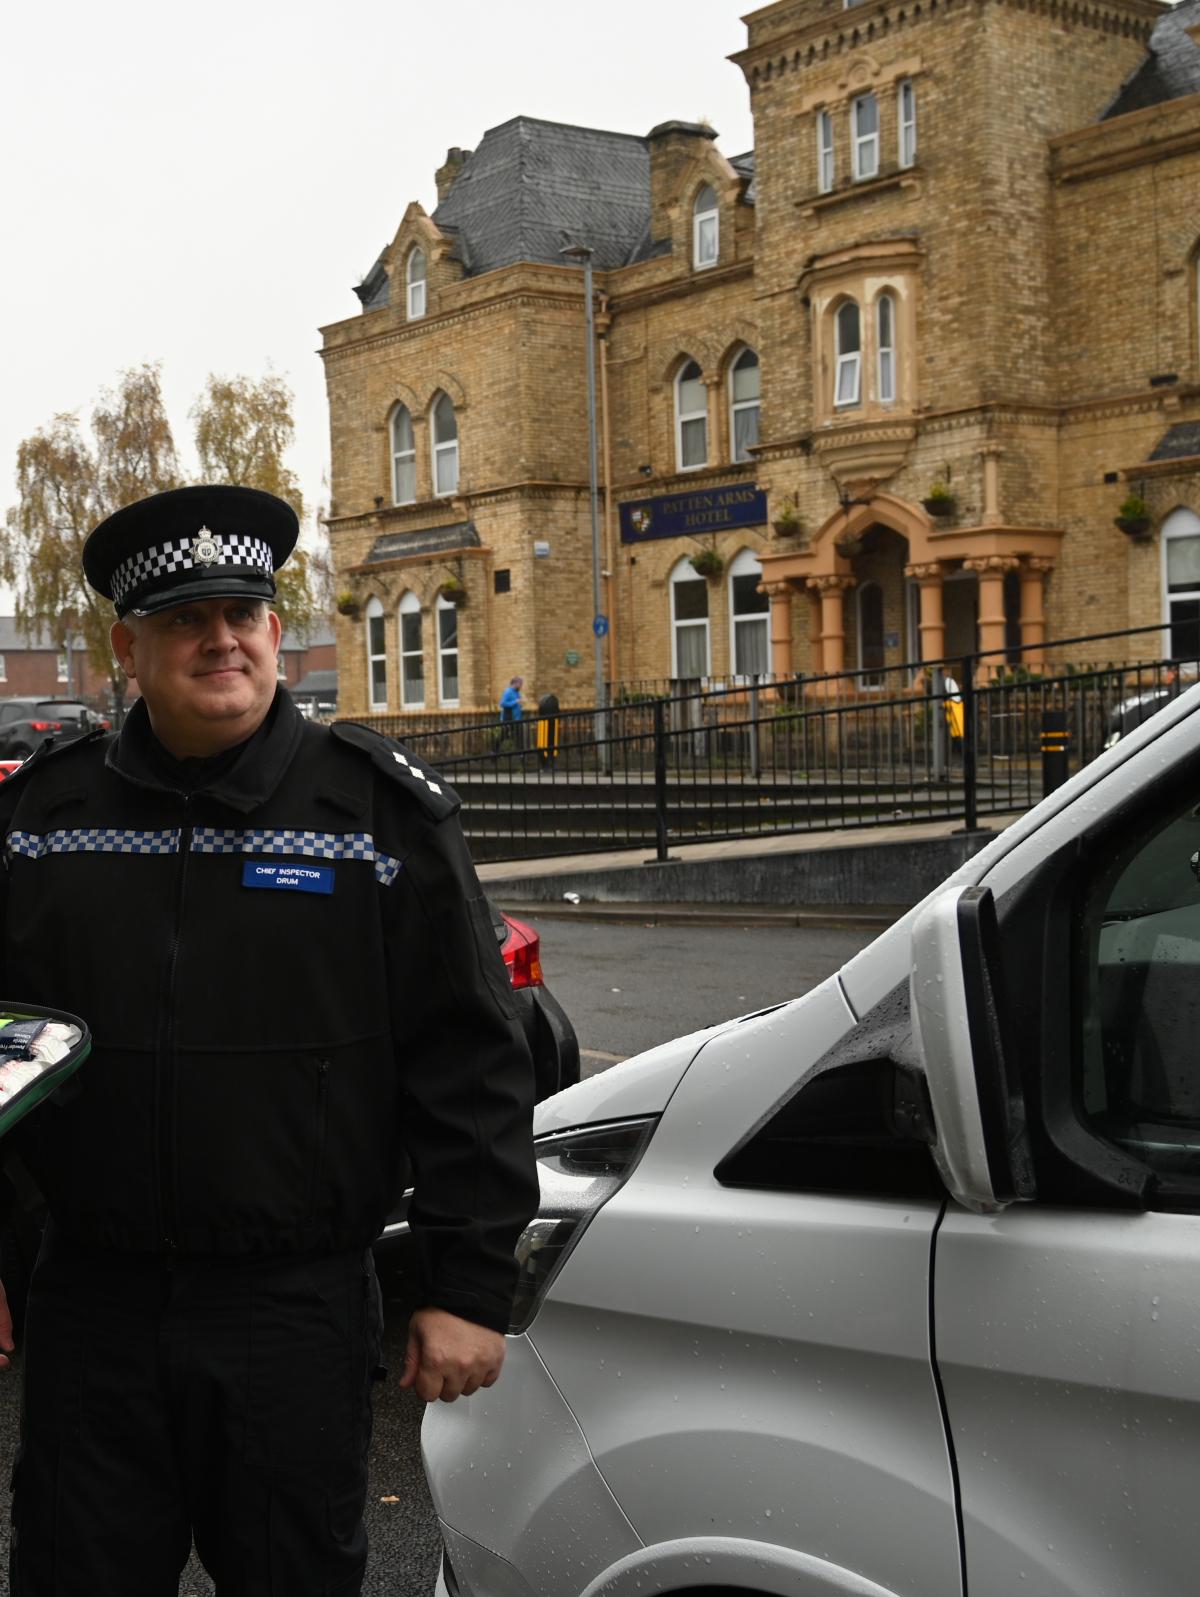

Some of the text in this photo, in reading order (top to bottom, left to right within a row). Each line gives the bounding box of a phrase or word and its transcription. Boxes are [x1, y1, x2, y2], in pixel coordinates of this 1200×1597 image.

[664, 491, 755, 514] PATTEN ARMS
[686, 508, 732, 526] HOTEL
[256, 867, 321, 879] CHIEF INSPECTOR
[276, 877, 298, 885] DRUM
